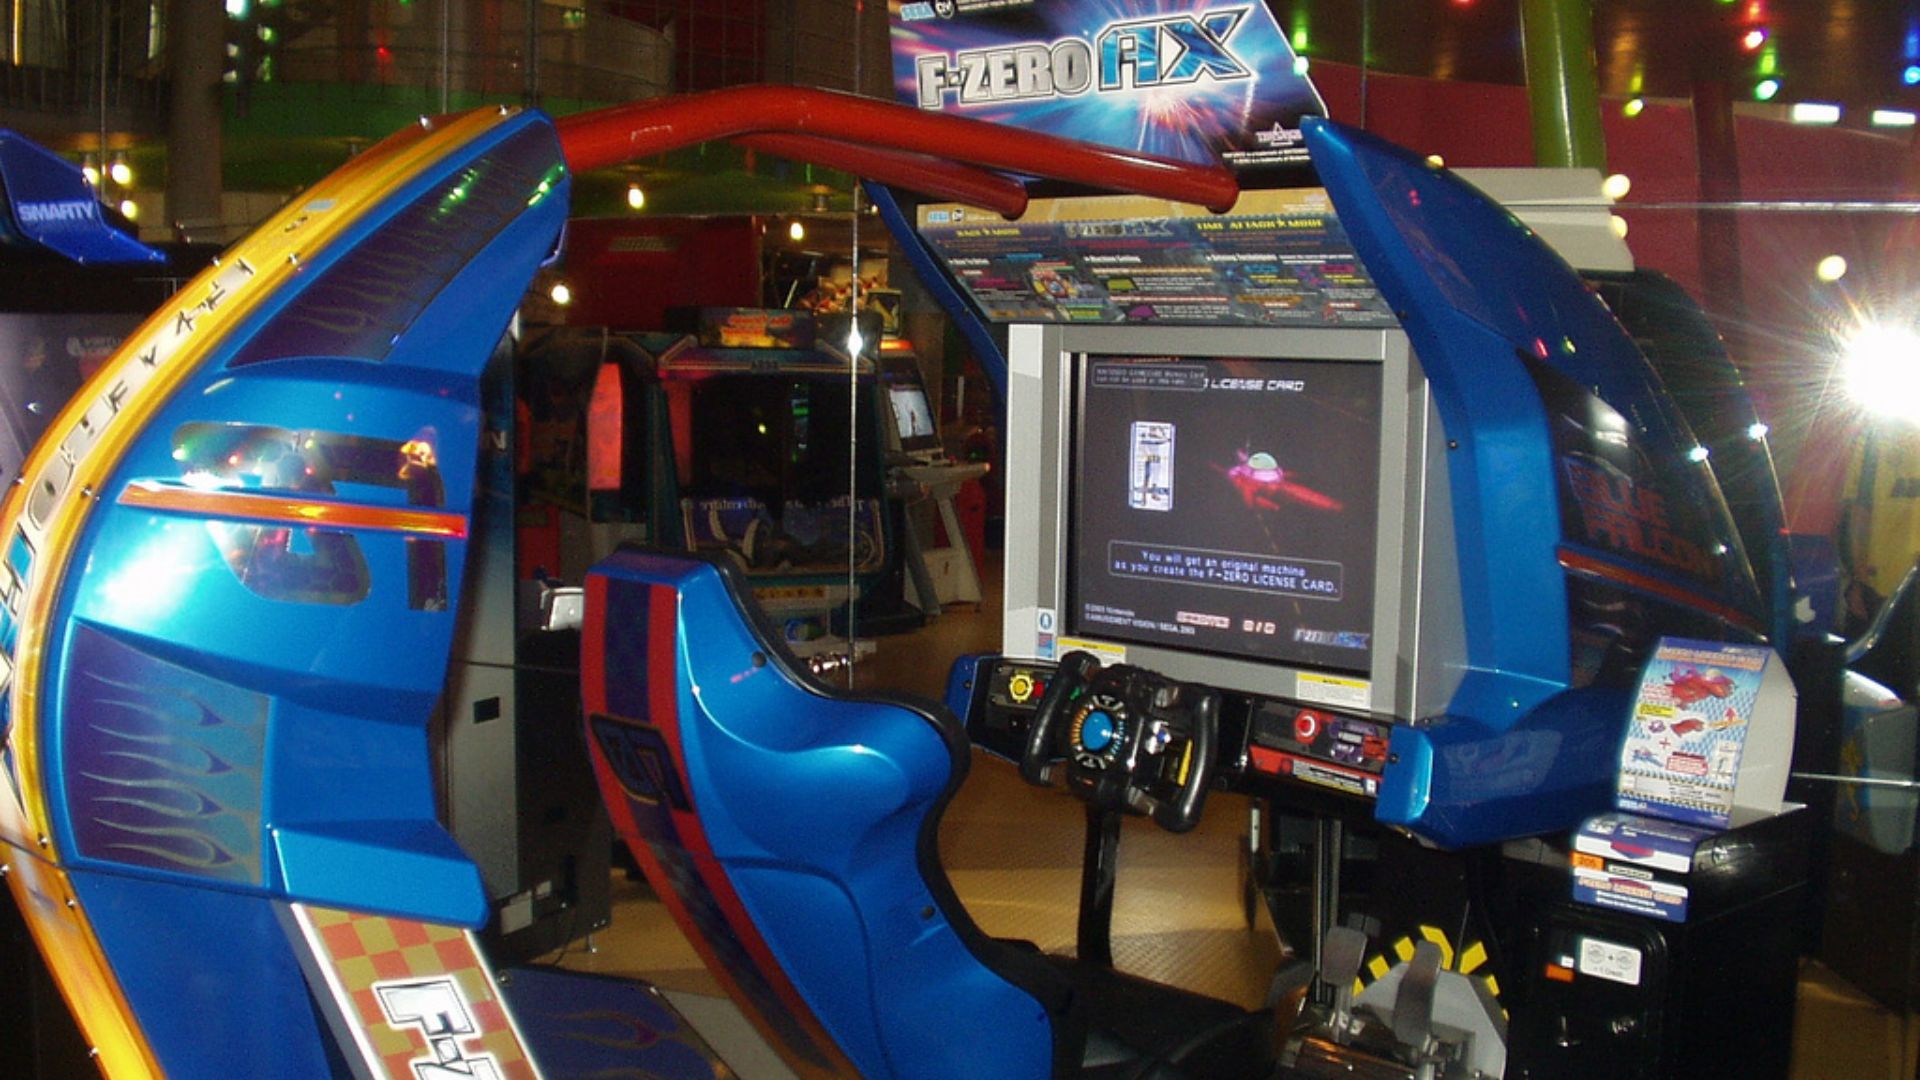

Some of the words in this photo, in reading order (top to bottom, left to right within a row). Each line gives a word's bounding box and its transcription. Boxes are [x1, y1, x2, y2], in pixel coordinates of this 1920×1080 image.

[917, 39, 1092, 108] F-ZERO
[1099, 5, 1254, 91] AX
[18, 202, 93, 221] SMARTY
[1211, 377, 1264, 391] LICENSE
[1267, 379, 1305, 392] CARD
[1114, 560, 1126, 570] as
[1131, 563, 1149, 573] you
[1153, 565, 1185, 576] create
[1188, 568, 1204, 578] the
[1208, 570, 1250, 583] F-ZERO
[1252, 575, 1296, 589] LICENSE
[1301, 579, 1338, 593] CARD.
[1141, 551, 1161, 562] You
[1165, 552, 1182, 563] will
[1185, 556, 1201, 567] get
[1205, 559, 1217, 567] an
[1220, 560, 1259, 573] original
[1261, 564, 1306, 577] machine
